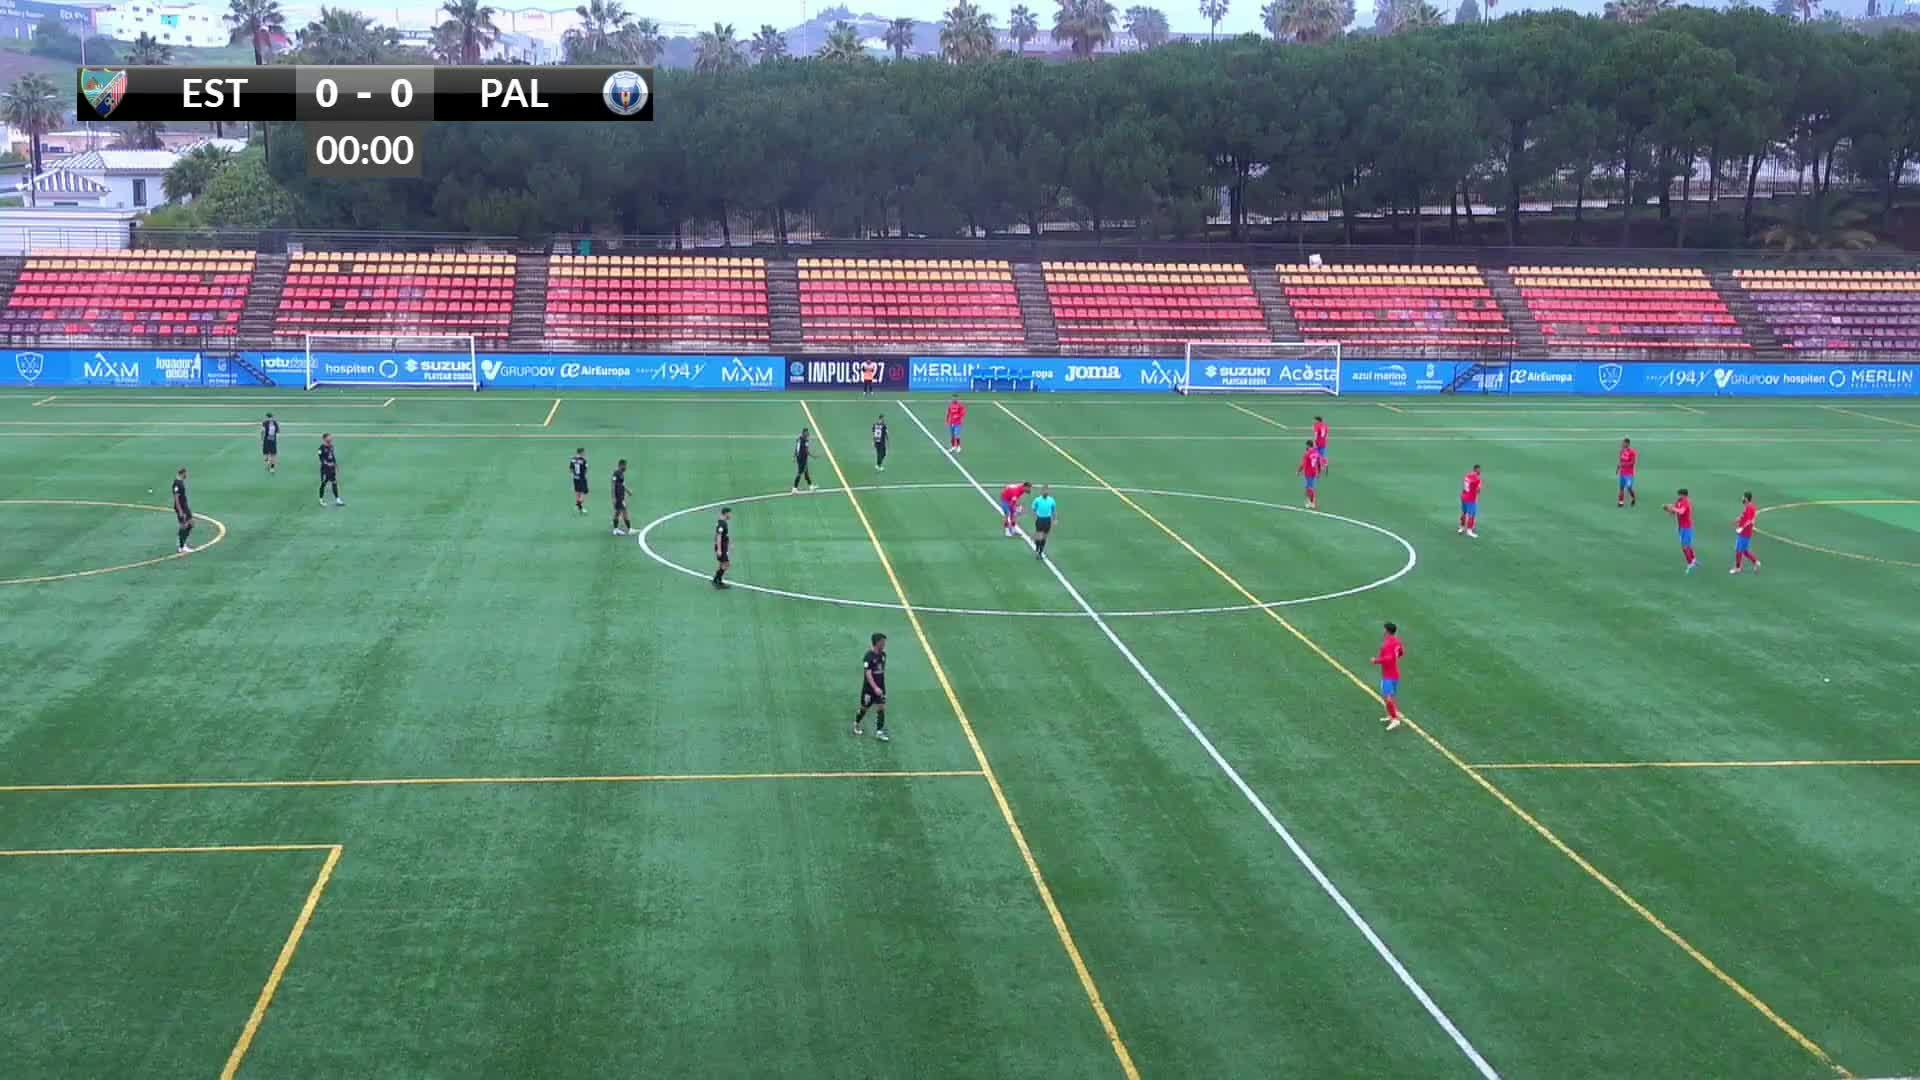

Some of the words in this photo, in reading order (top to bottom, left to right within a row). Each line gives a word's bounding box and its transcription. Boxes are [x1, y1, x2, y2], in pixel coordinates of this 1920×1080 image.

[420, 360, 474, 371] SUZUK
[1219, 367, 1271, 377] SUZUKI
[1851, 369, 1914, 383] MERLIN
